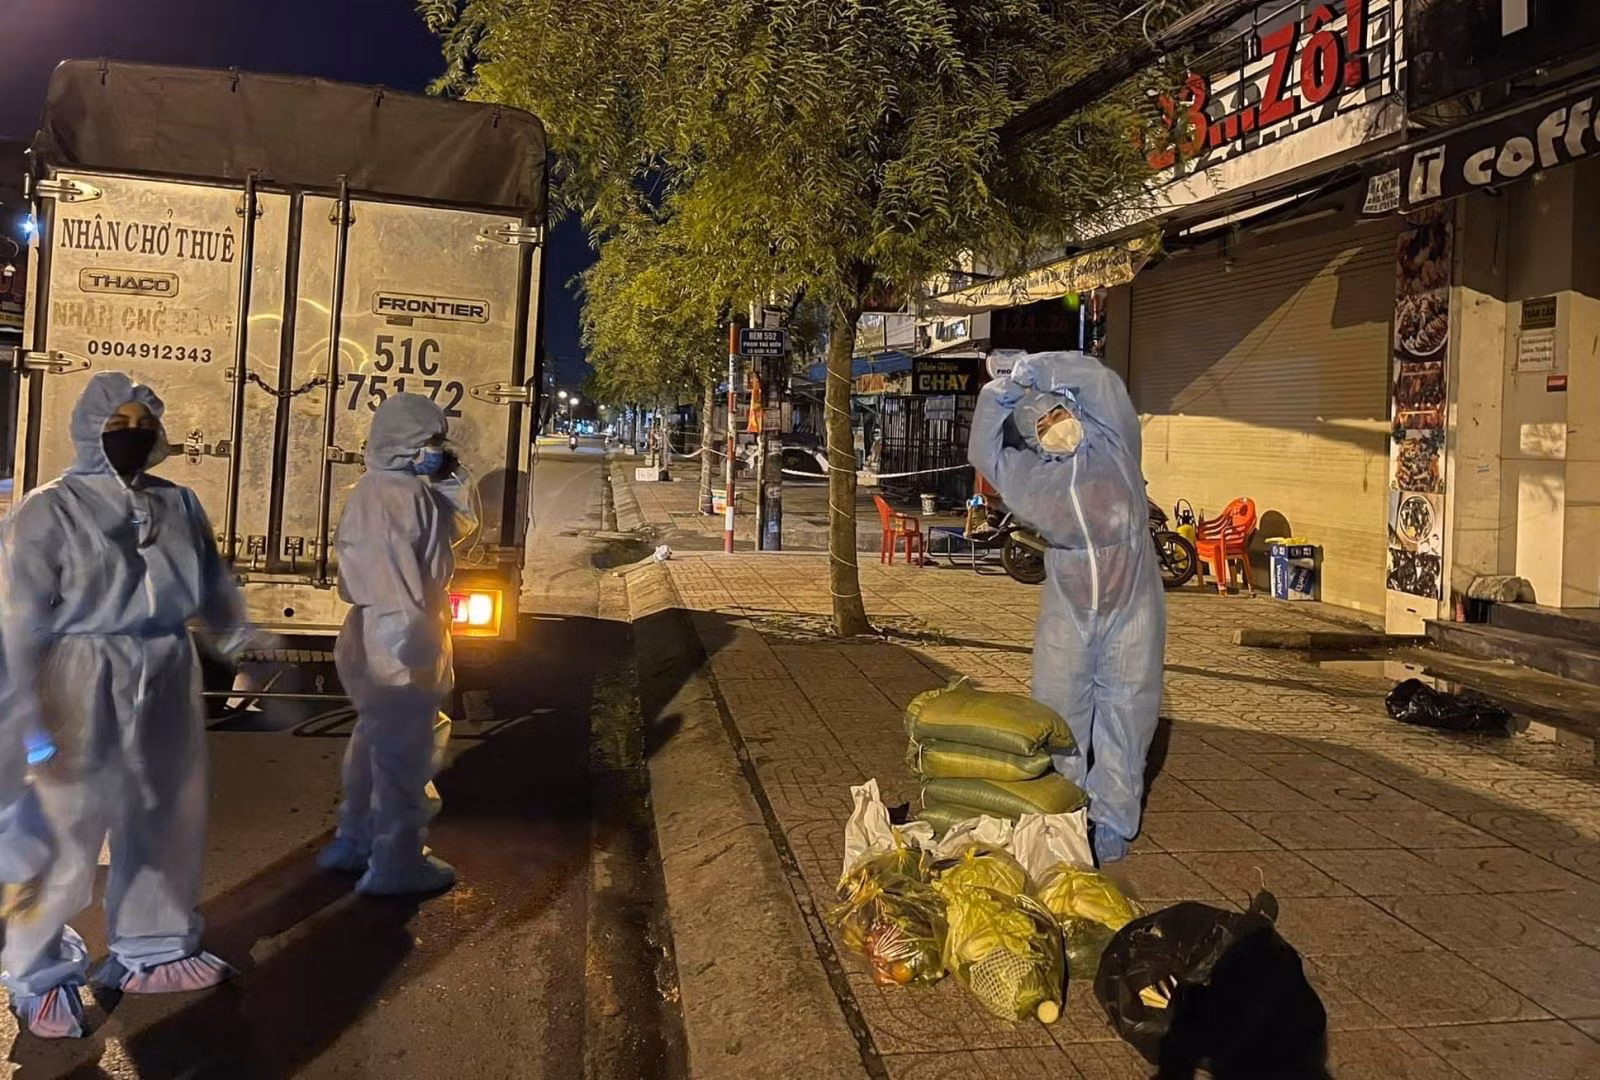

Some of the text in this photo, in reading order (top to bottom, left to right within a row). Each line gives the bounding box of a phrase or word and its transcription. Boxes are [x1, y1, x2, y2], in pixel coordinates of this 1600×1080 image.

[1463, 96, 1600, 186] coff
[60, 208, 235, 263] NHẬN CHỞ THUÊ
[88, 273, 171, 292] THACO
[378, 297, 484, 318] FRONTIER
[87, 339, 212, 364] 0904912343
[374, 335, 440, 376] 51C
